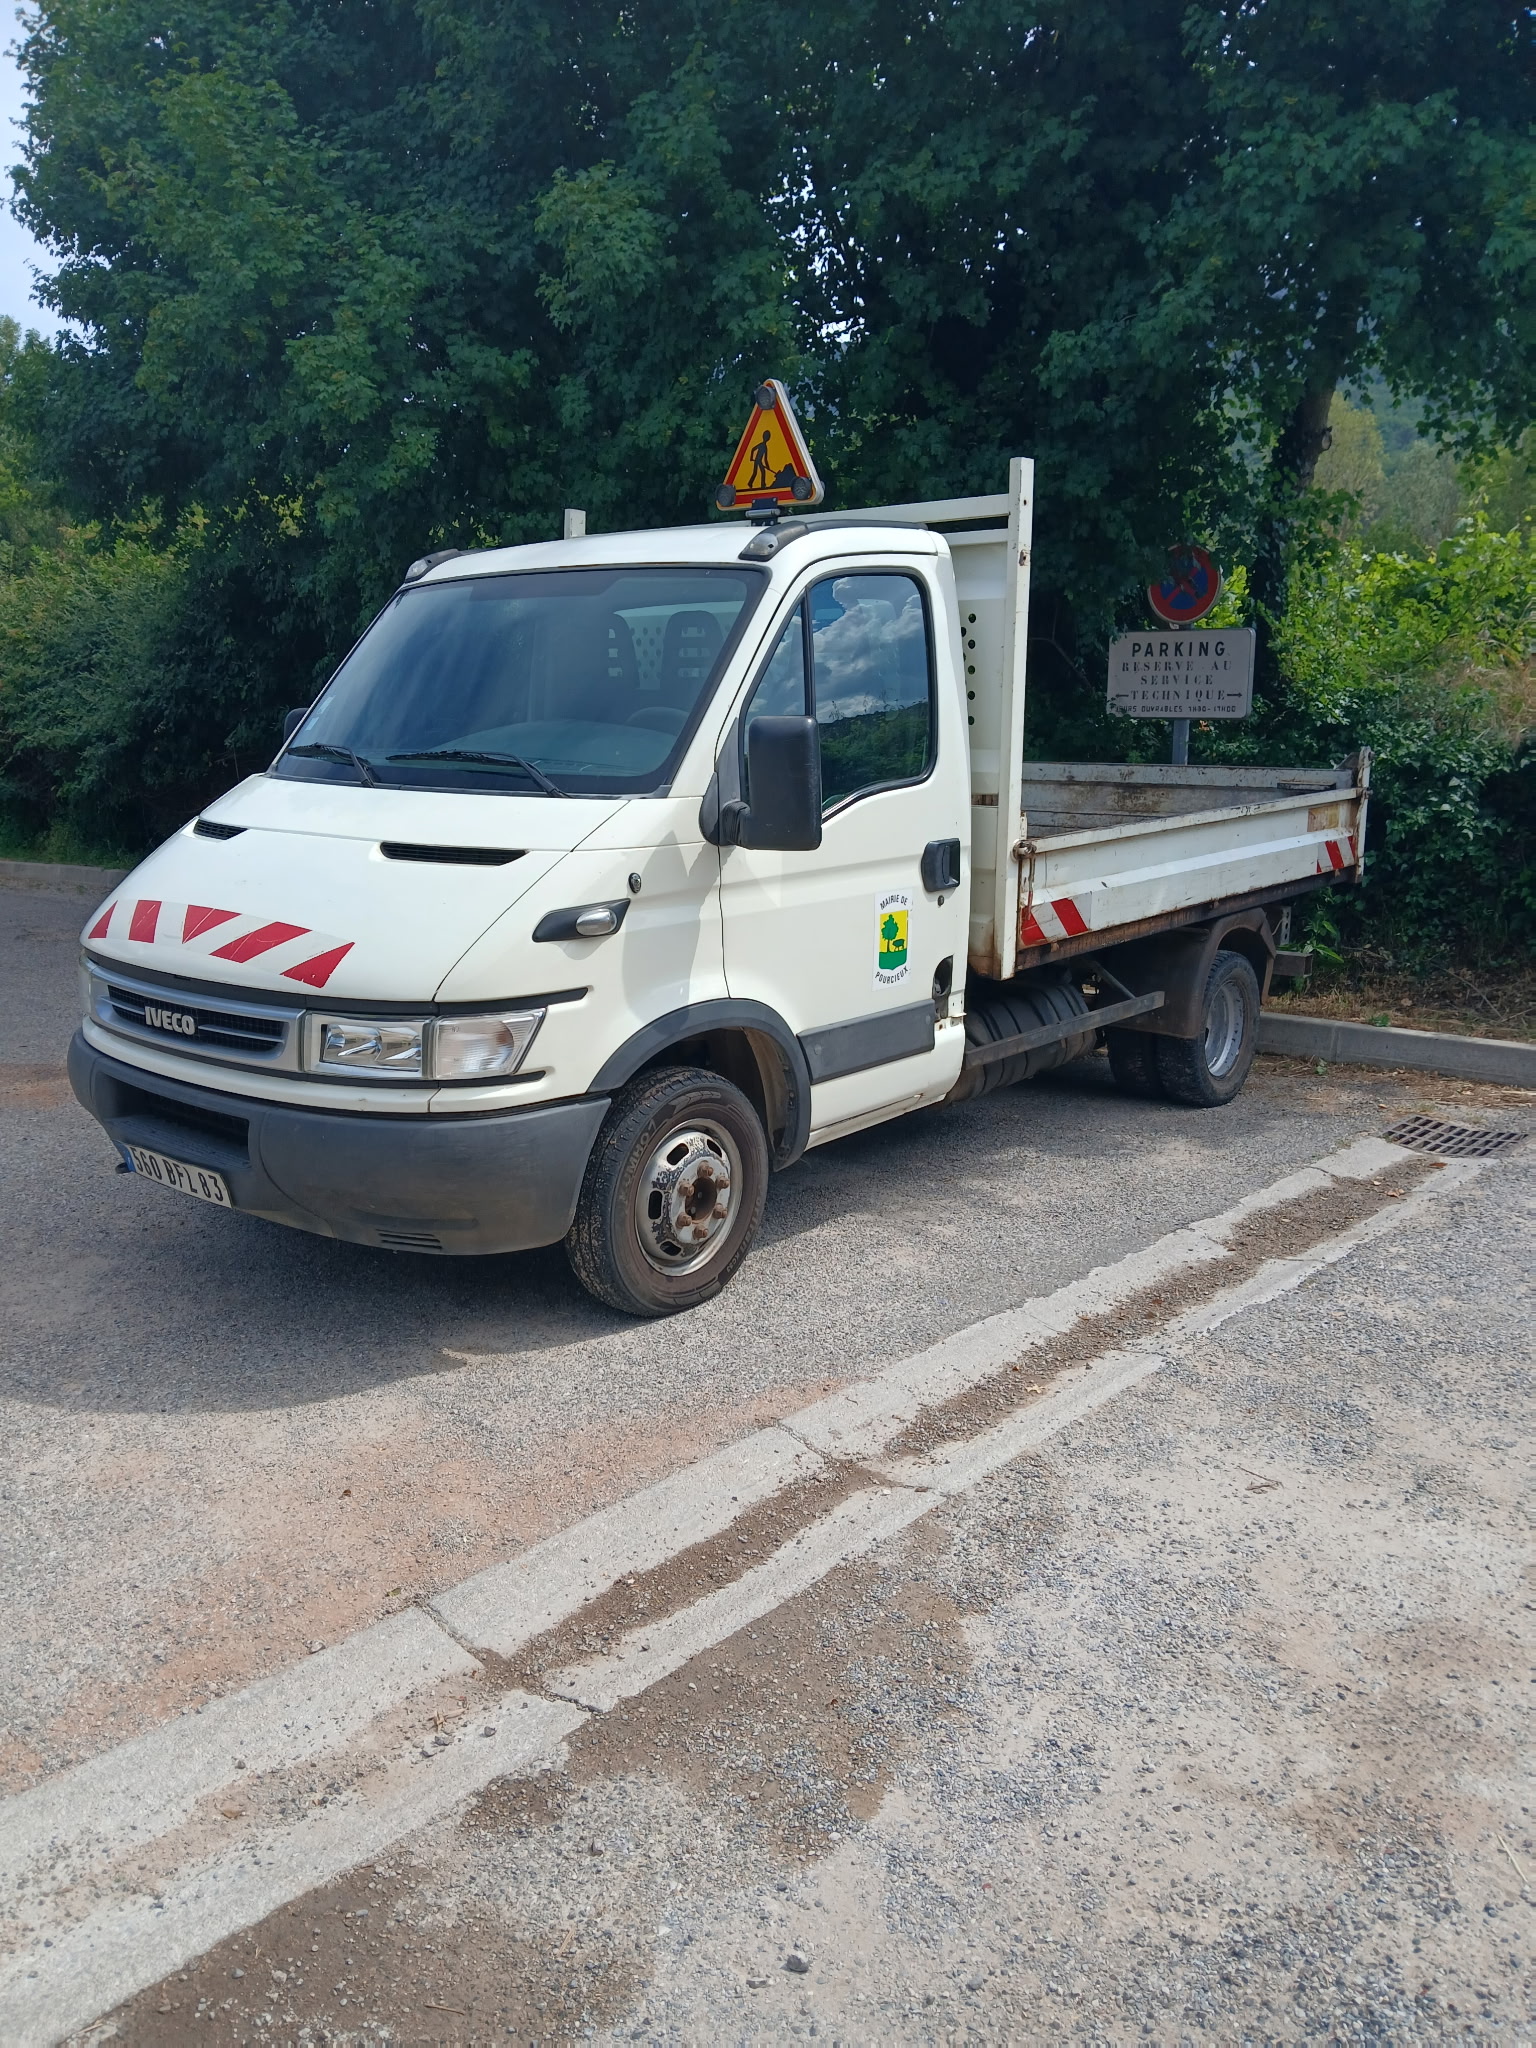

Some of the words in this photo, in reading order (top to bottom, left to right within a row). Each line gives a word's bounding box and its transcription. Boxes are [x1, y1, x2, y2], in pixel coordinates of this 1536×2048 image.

[1131, 641, 1226, 658] PARKING
[1121, 661, 1195, 673] RESERVE
[1211, 660, 1233, 672] AU
[1140, 674, 1214, 686] SERVICE
[1130, 689, 1226, 702] TECHNIQUE
[1141, 705, 1183, 713] OUVRABLES
[879, 894, 900, 910] MAIRIE
[900, 895, 908, 906] DE
[874, 965, 909, 984] POURCIEUX
[144, 1005, 196, 1036] IVECO
[129, 1146, 162, 1180] 560
[197, 1171, 224, 1202] 83
